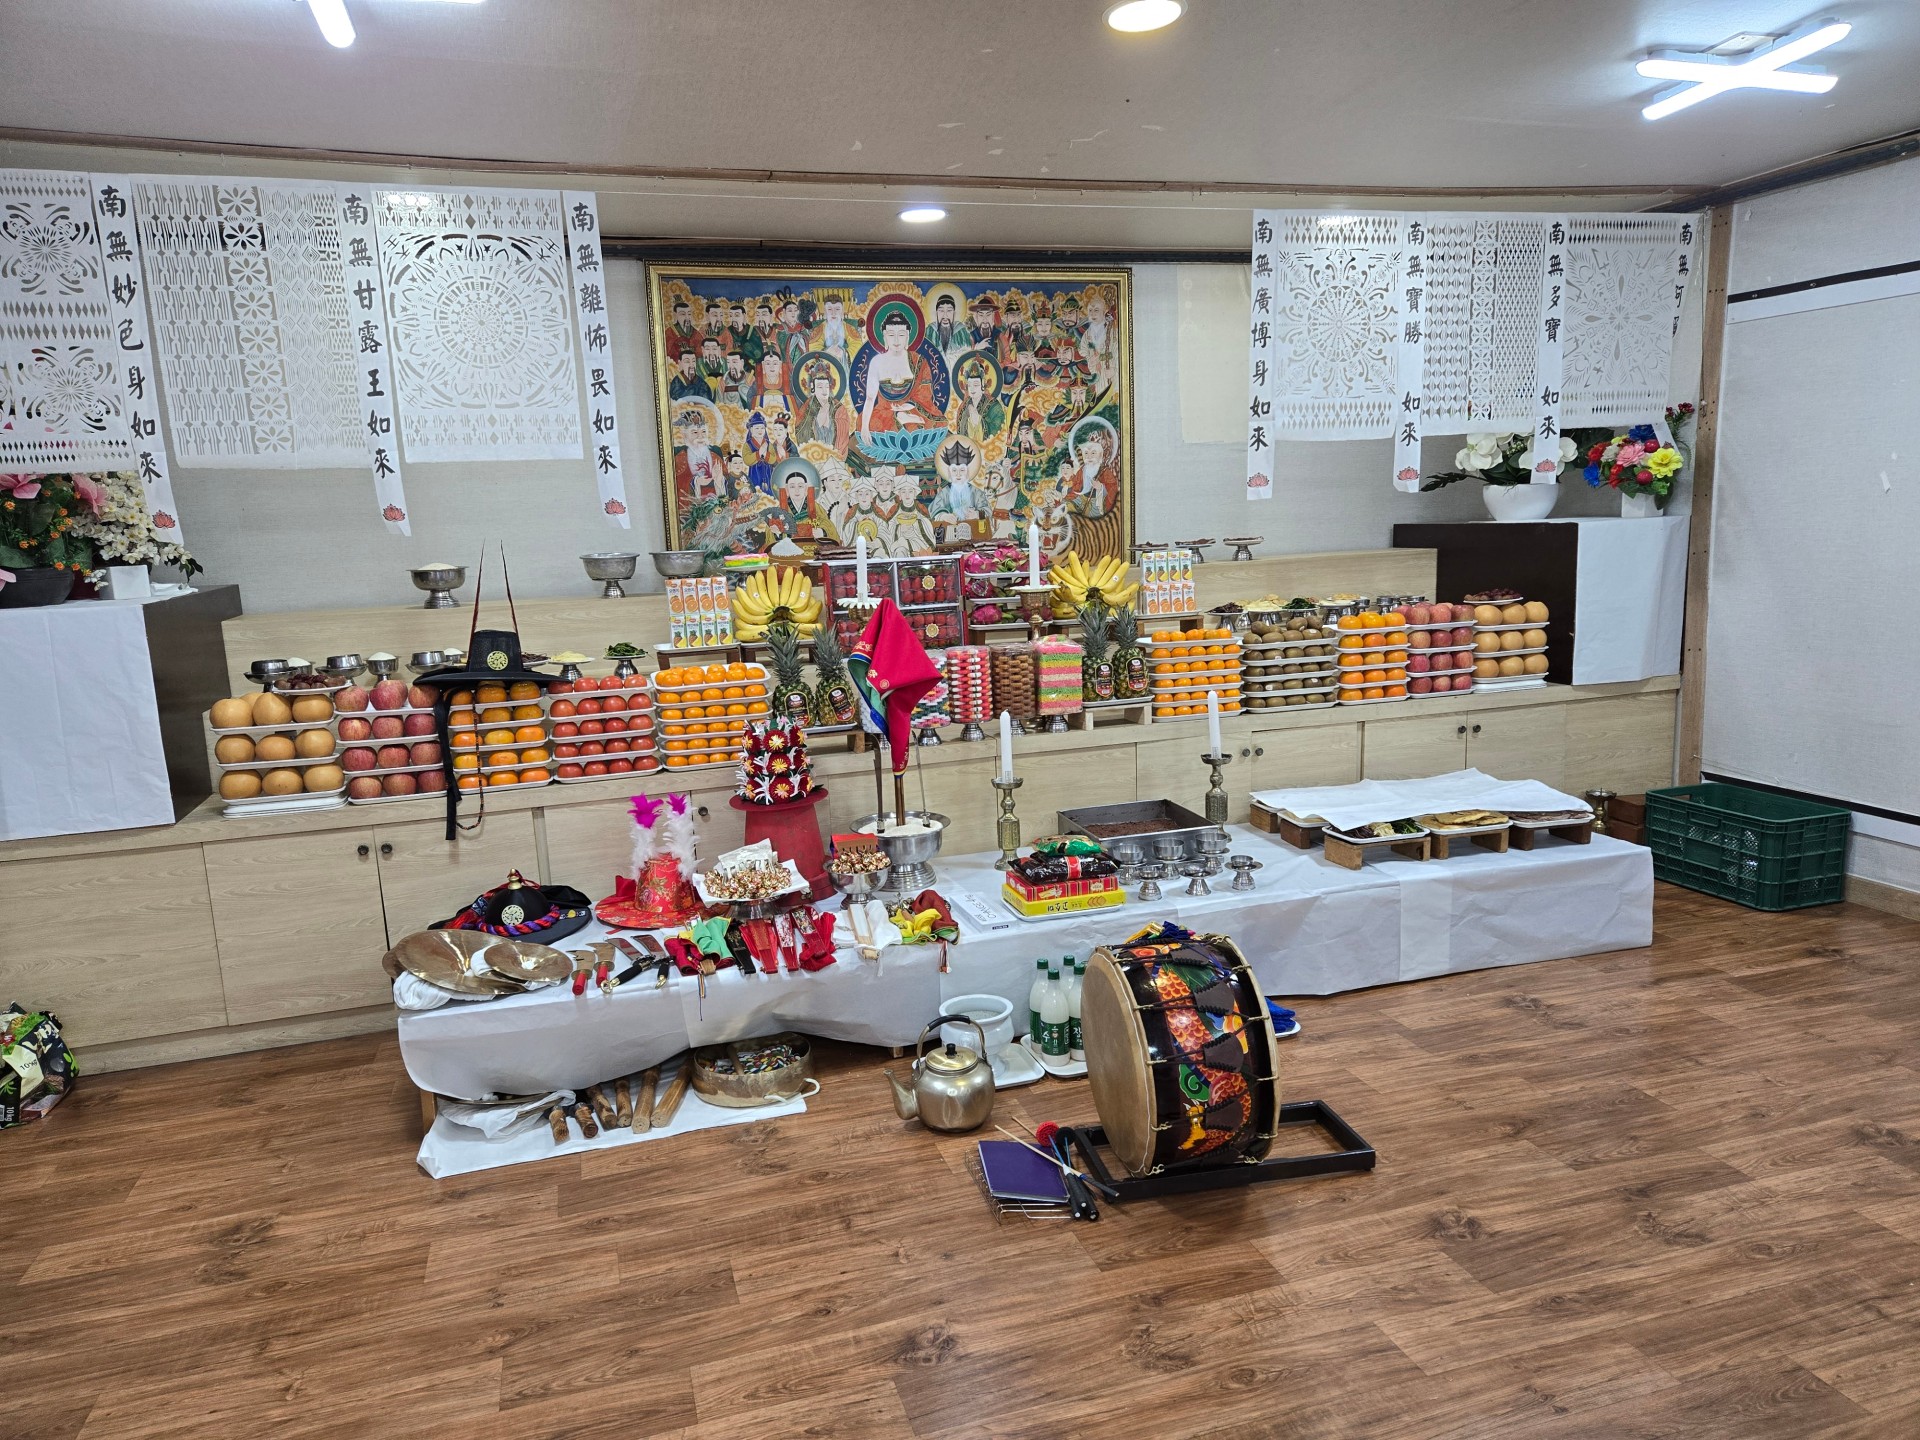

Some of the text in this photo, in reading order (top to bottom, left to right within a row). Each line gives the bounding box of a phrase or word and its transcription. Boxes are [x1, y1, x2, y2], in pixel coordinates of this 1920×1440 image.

[100, 185, 162, 483] 南無妙色身如來
[343, 194, 395, 478] 南無甘露王如來
[571, 202, 617, 474] 南無離怖畏如來
[1250, 218, 1273, 451] 南無廣博身如來
[5, 1107, 14, 1121] 10kg
